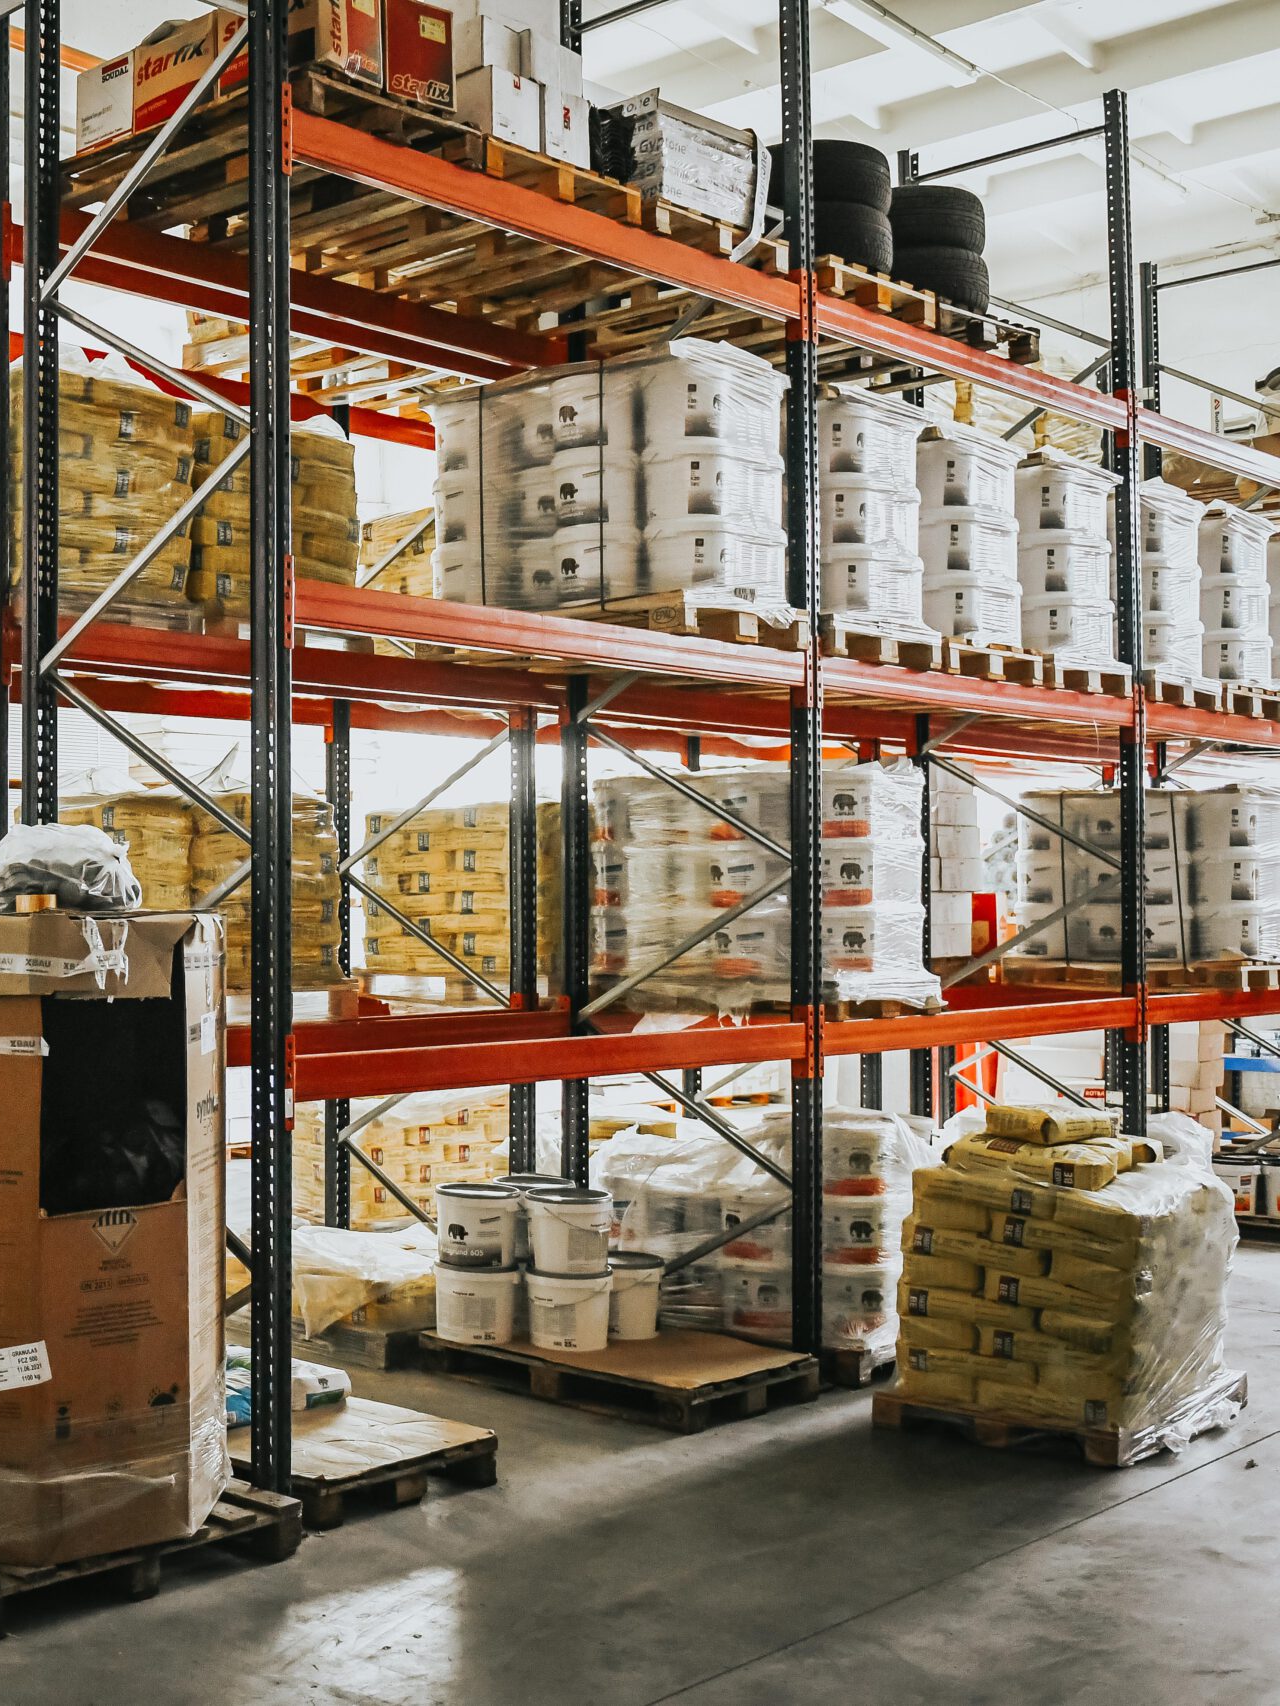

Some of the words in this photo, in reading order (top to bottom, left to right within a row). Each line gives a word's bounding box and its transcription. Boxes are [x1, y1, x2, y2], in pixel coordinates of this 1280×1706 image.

[136, 34, 209, 87] starfix
[102, 65, 129, 84] SOUDAL
[391, 73, 450, 102] starfix
[470, 1249, 484, 1257] 605
